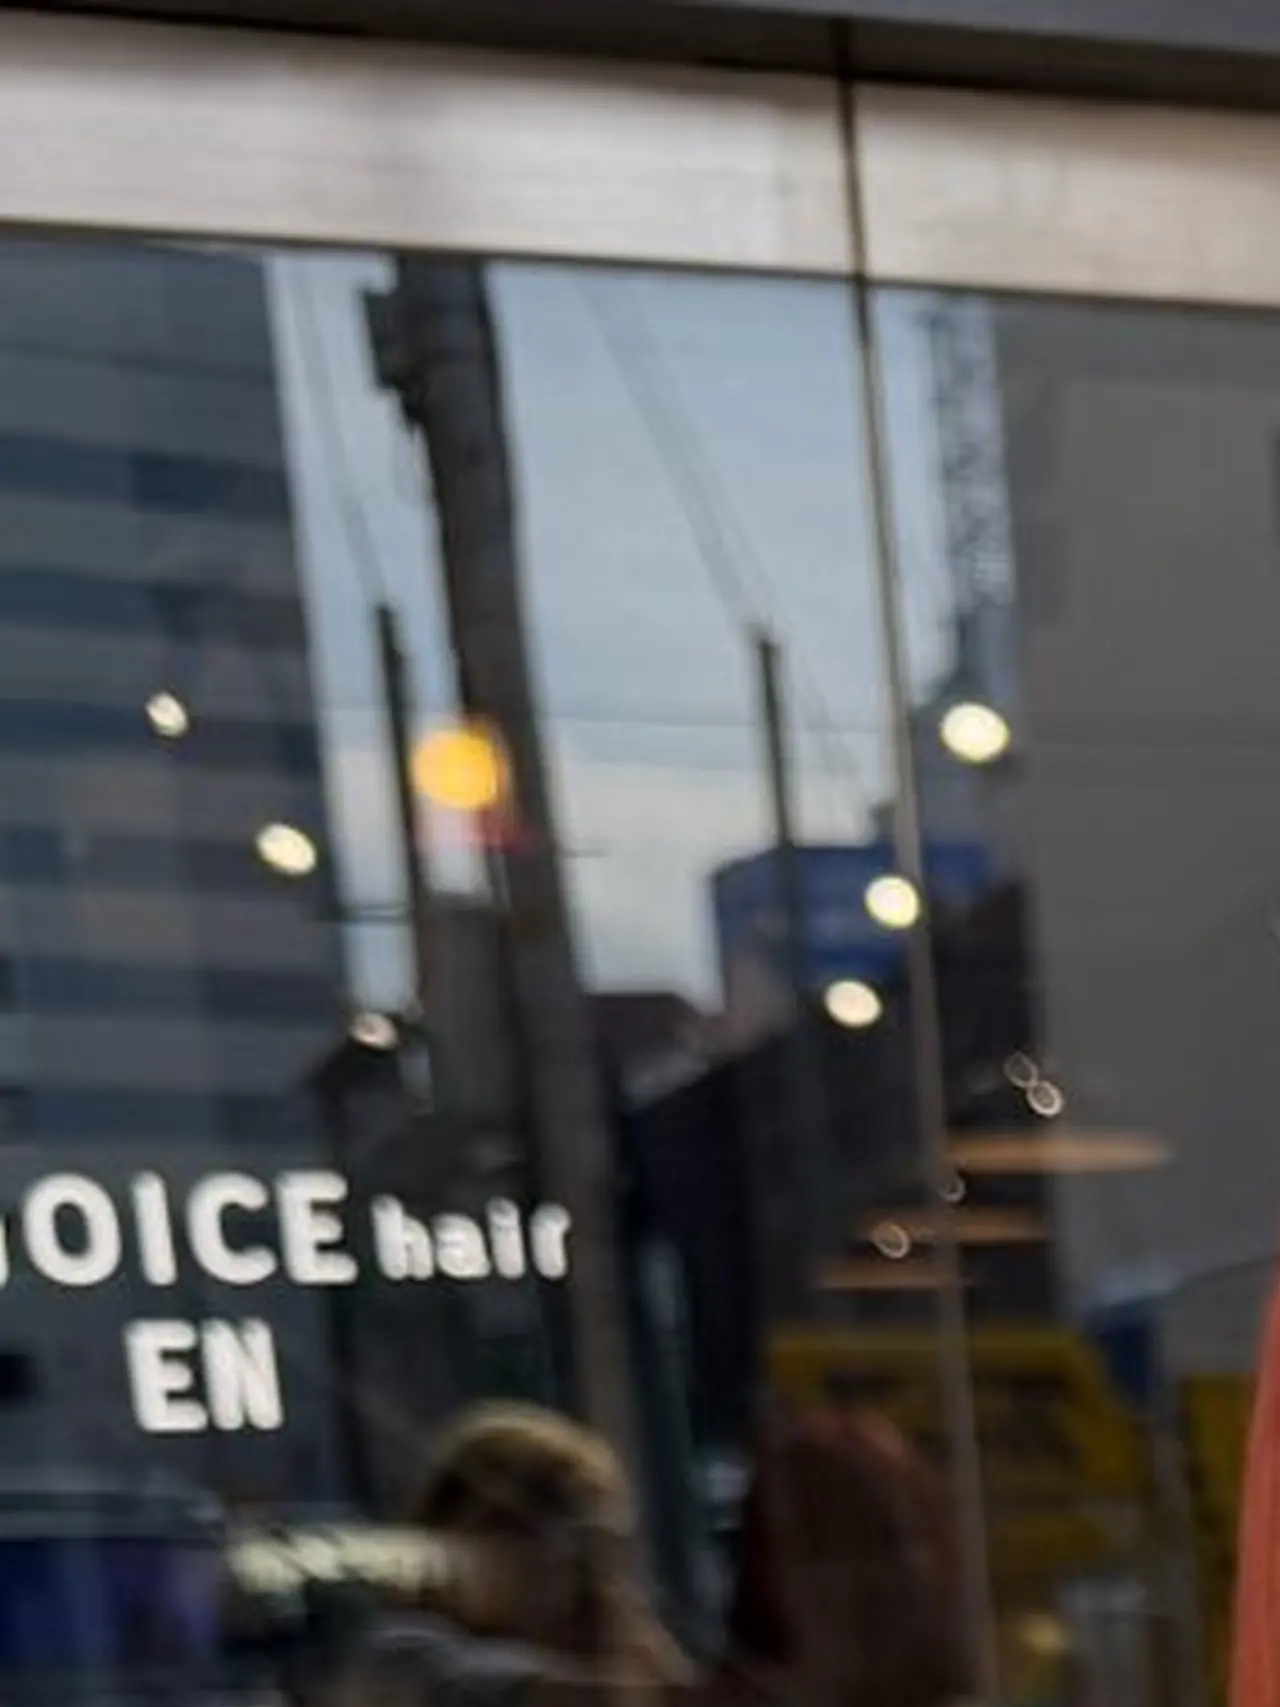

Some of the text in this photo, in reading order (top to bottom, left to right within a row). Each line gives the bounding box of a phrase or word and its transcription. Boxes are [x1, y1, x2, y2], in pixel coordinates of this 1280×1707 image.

[0, 1170, 571, 1286] OICE hair
[124, 1318, 283, 1432] EN
